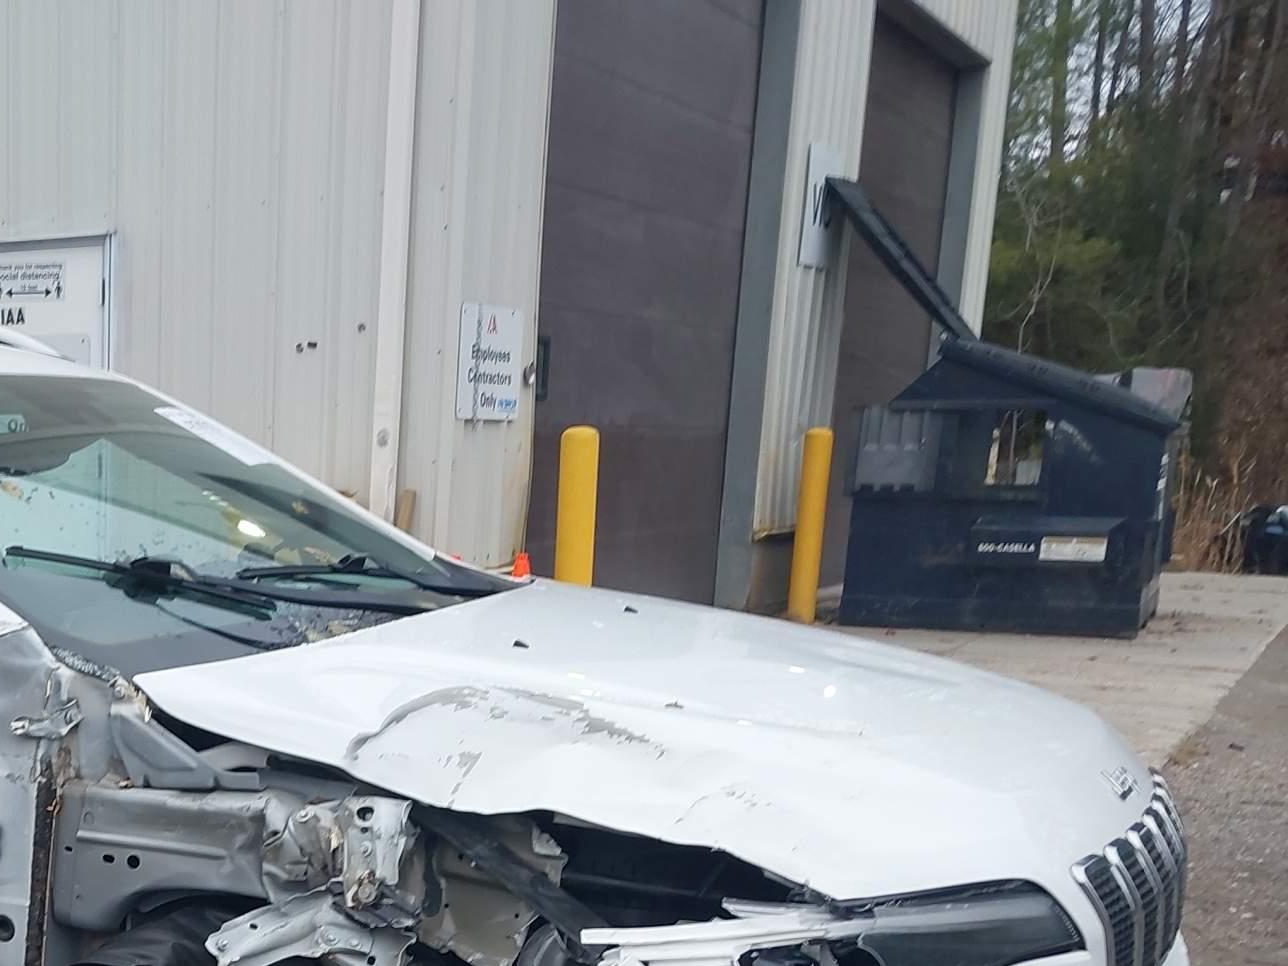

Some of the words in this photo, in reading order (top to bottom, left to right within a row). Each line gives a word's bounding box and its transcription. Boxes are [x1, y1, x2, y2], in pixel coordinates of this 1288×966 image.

[0, 307, 26, 326] IAA
[471, 343, 511, 364] Employees
[467, 367, 512, 386] Contractors
[479, 391, 497, 411] Only
